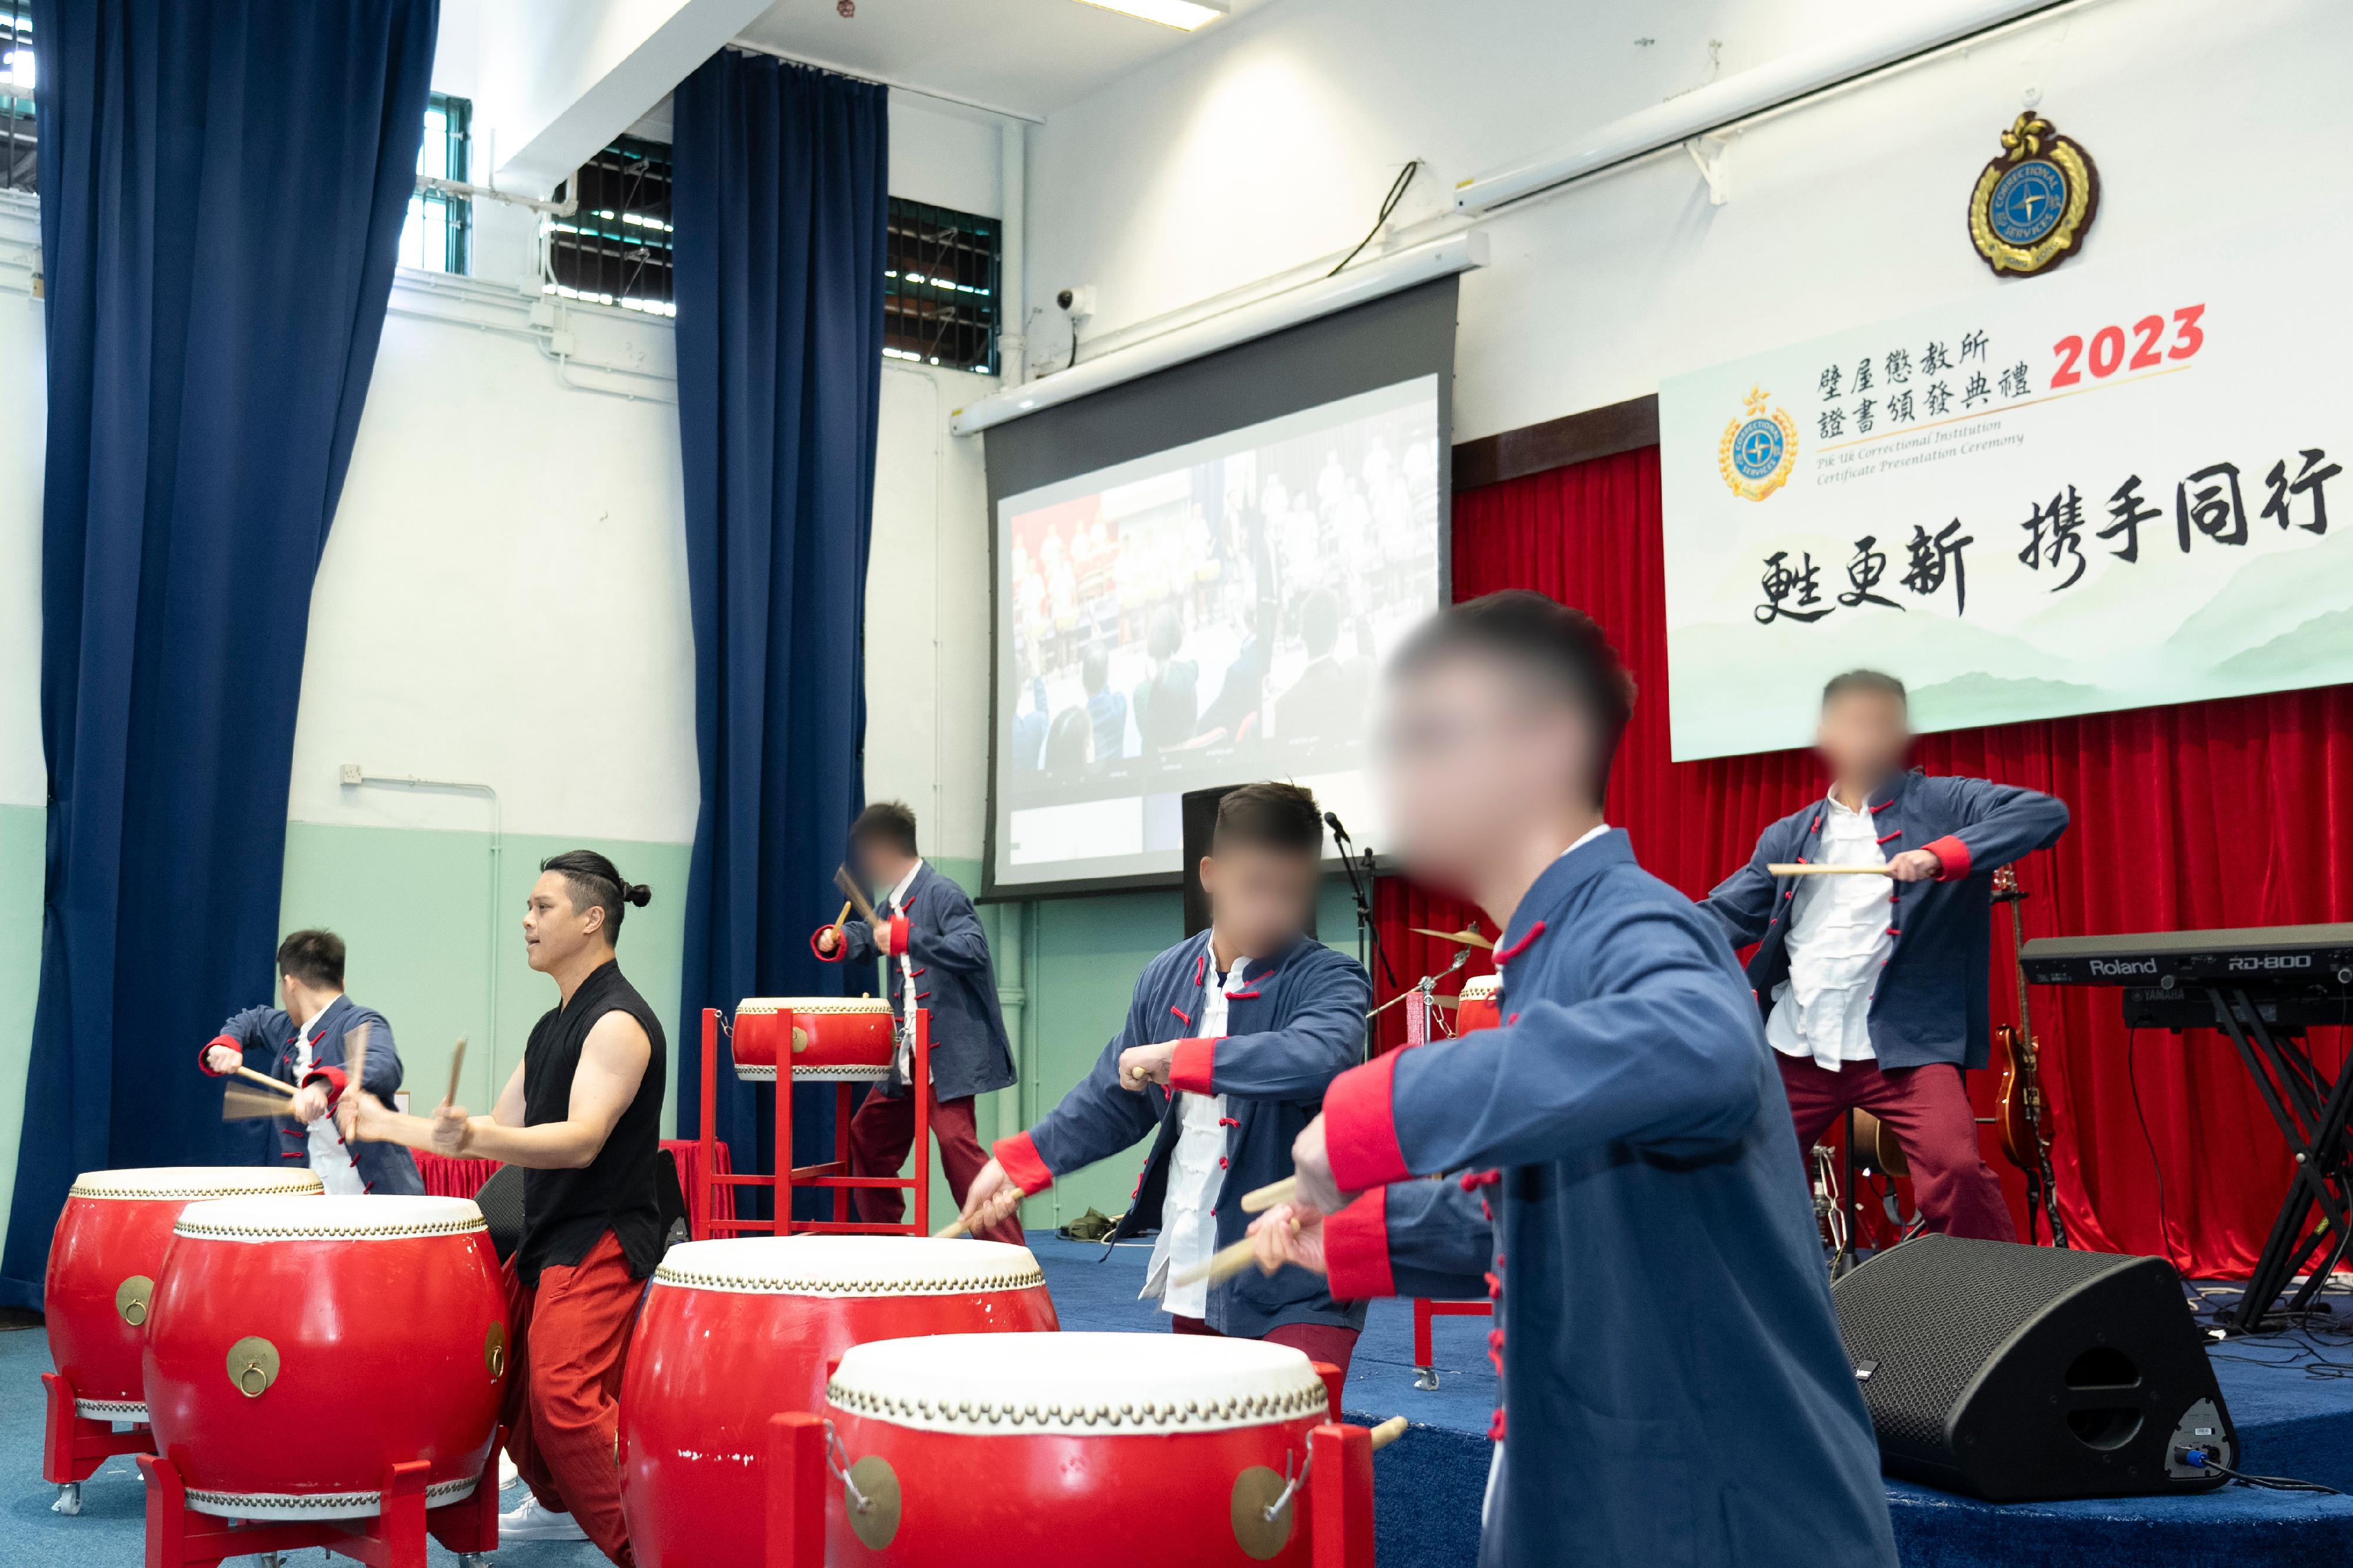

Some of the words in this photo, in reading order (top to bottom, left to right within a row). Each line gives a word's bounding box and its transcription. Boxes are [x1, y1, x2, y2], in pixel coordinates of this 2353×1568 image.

[1995, 165, 2059, 208] CORRECTIONAL
[2004, 212, 2054, 238] SERVICES
[1817, 329, 1989, 402] 壁屋懲教所
[2050, 303, 2205, 389] 2023
[1817, 361, 2031, 439] 證書頒發典禮
[1735, 422, 1779, 451] CORRECTIONAL
[1817, 453, 1835, 469] Pik
[1838, 452, 1855, 465] Uk
[1858, 431, 1932, 461] Correctional
[1934, 420, 2002, 444] Institution
[1817, 465, 1876, 486] Certificate
[1879, 448, 1958, 472] Presentation
[1960, 432, 2025, 455] Ceremony
[1742, 459, 1776, 476] SERVICES
[1754, 516, 1974, 625] 甦更新
[2089, 958, 2158, 976] Roland
[2228, 955, 2311, 970] RD-800
[2146, 988, 2184, 1000] YAMAHA
